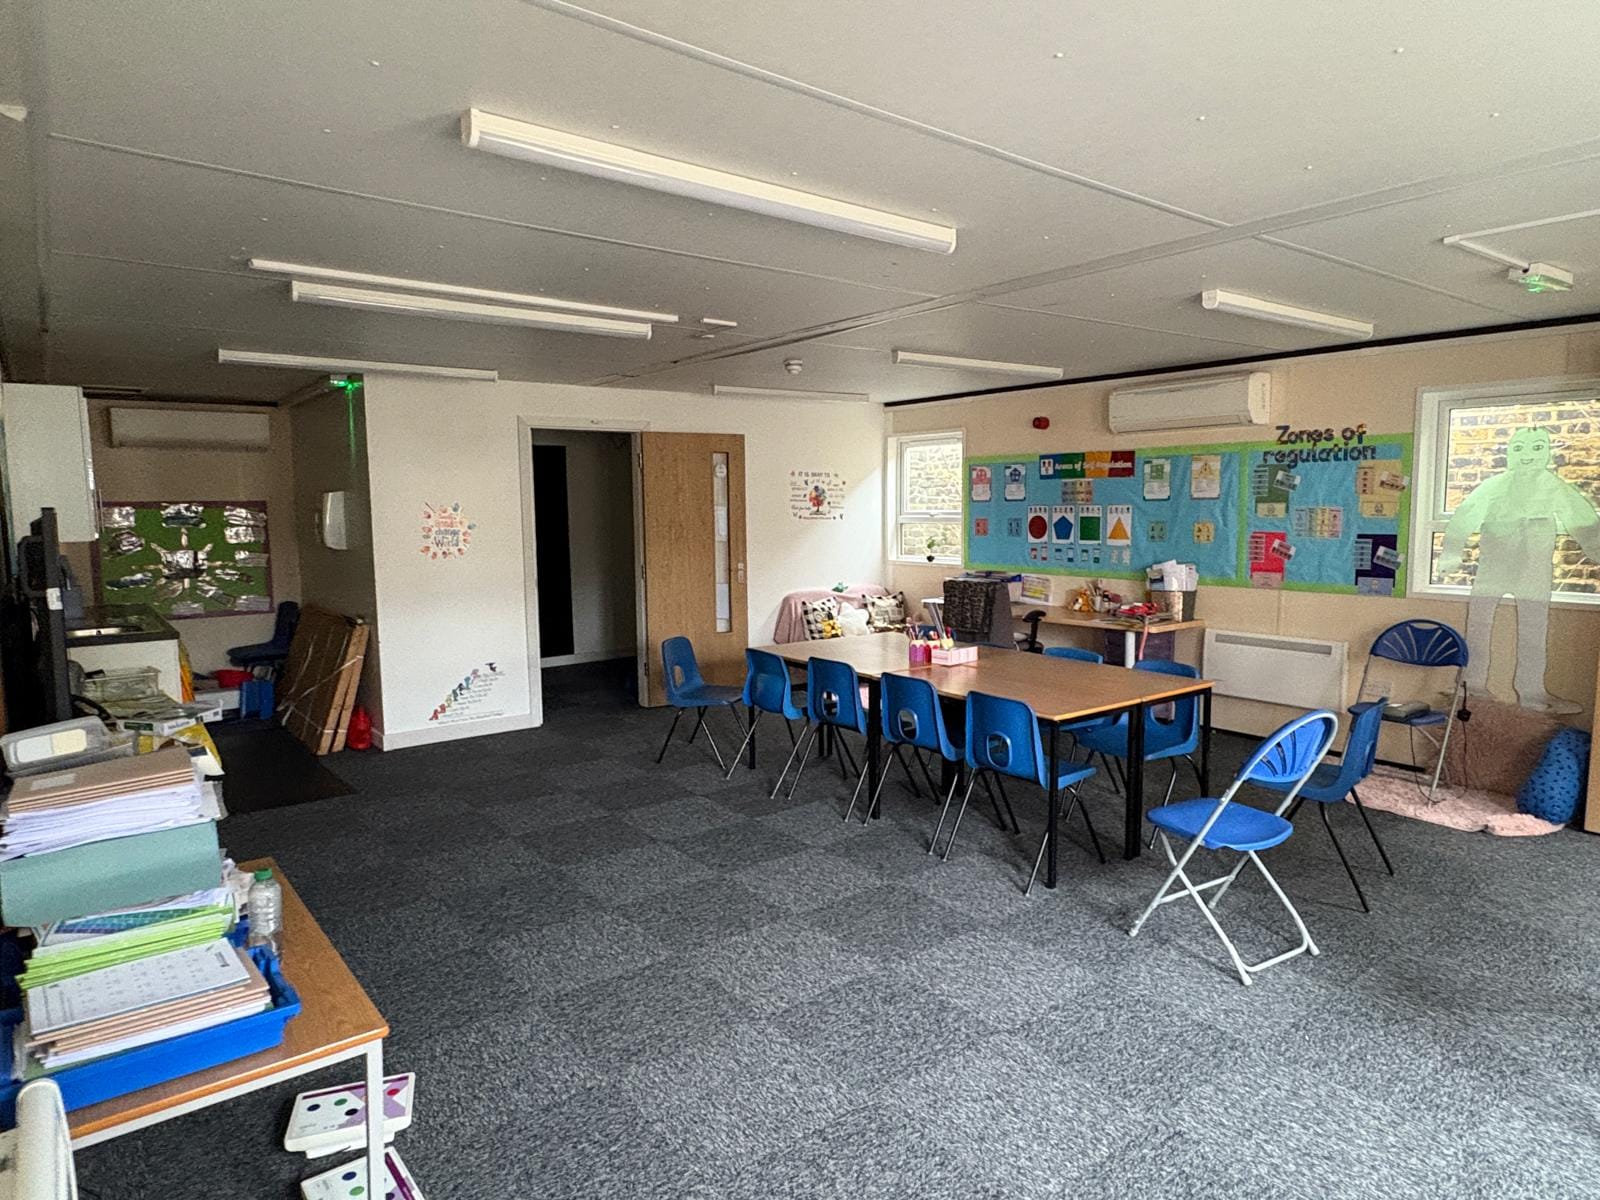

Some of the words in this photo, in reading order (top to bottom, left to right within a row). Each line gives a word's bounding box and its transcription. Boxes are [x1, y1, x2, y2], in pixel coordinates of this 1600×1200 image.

[1275, 425, 1335, 445] Zones
[1341, 423, 1367, 445] of
[1263, 440, 1377, 469] regulation
[1074, 461, 1082, 471] of
